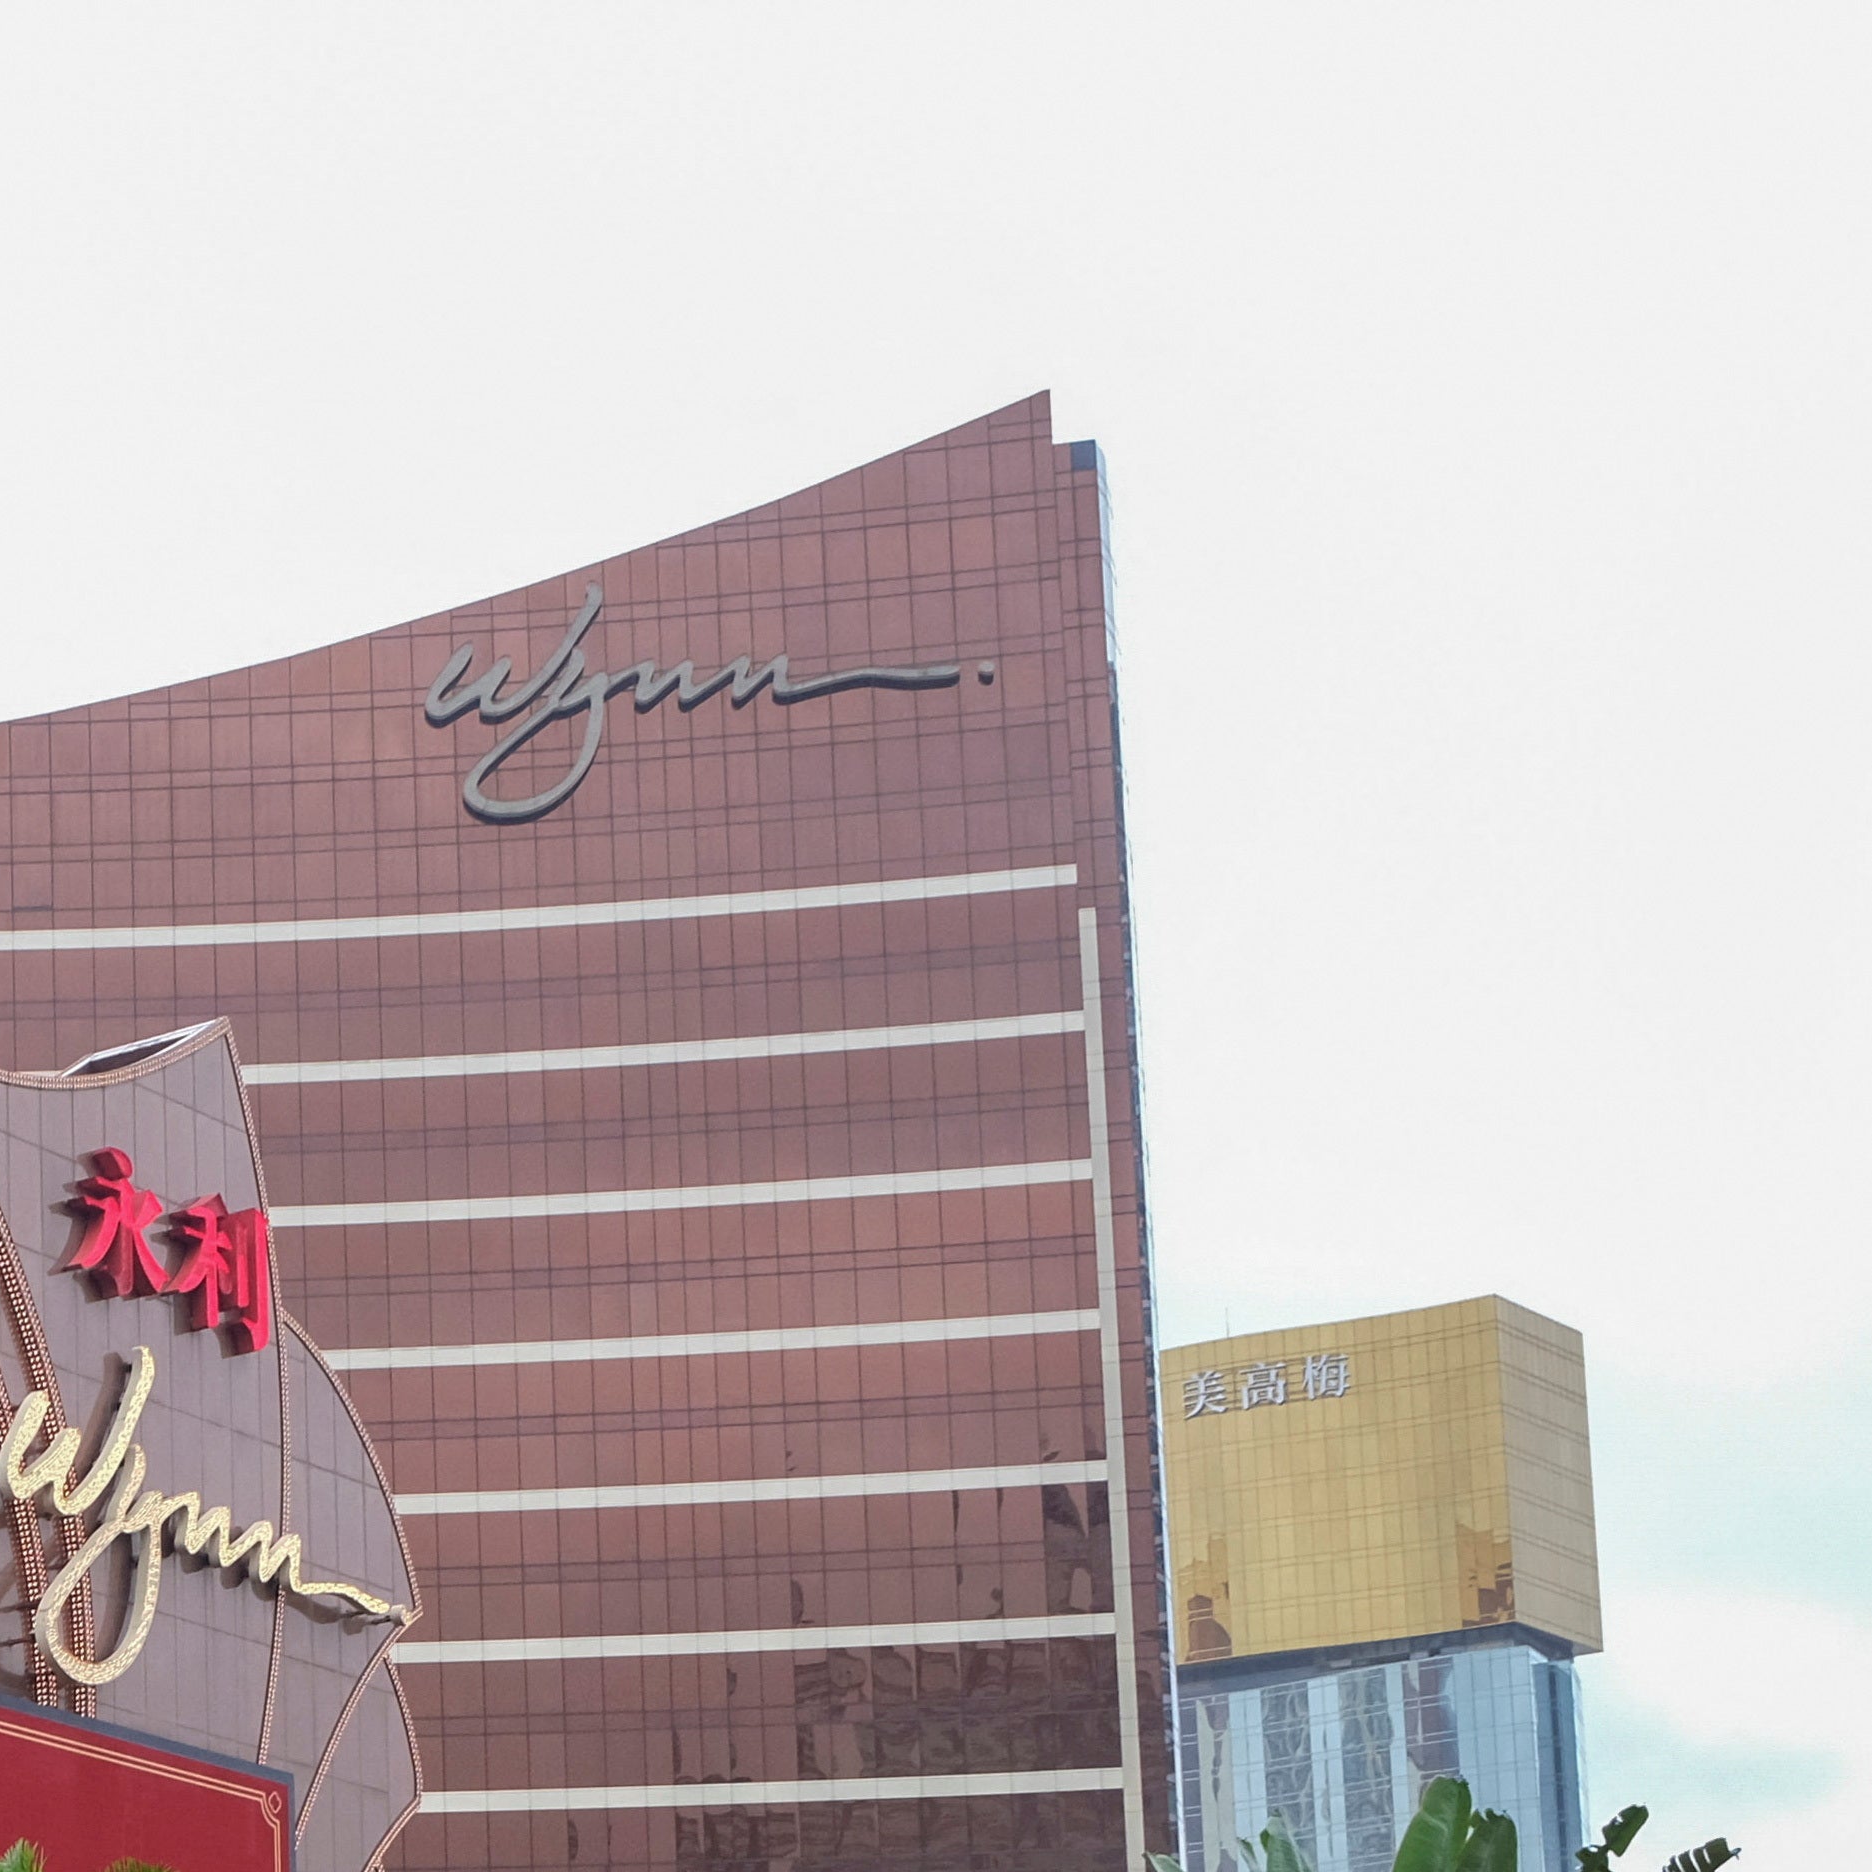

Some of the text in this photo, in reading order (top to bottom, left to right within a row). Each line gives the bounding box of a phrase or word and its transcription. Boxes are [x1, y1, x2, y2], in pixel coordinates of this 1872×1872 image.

[52, 1147, 270, 1358] 永利
[1182, 1352, 1352, 1421] 美高梅
